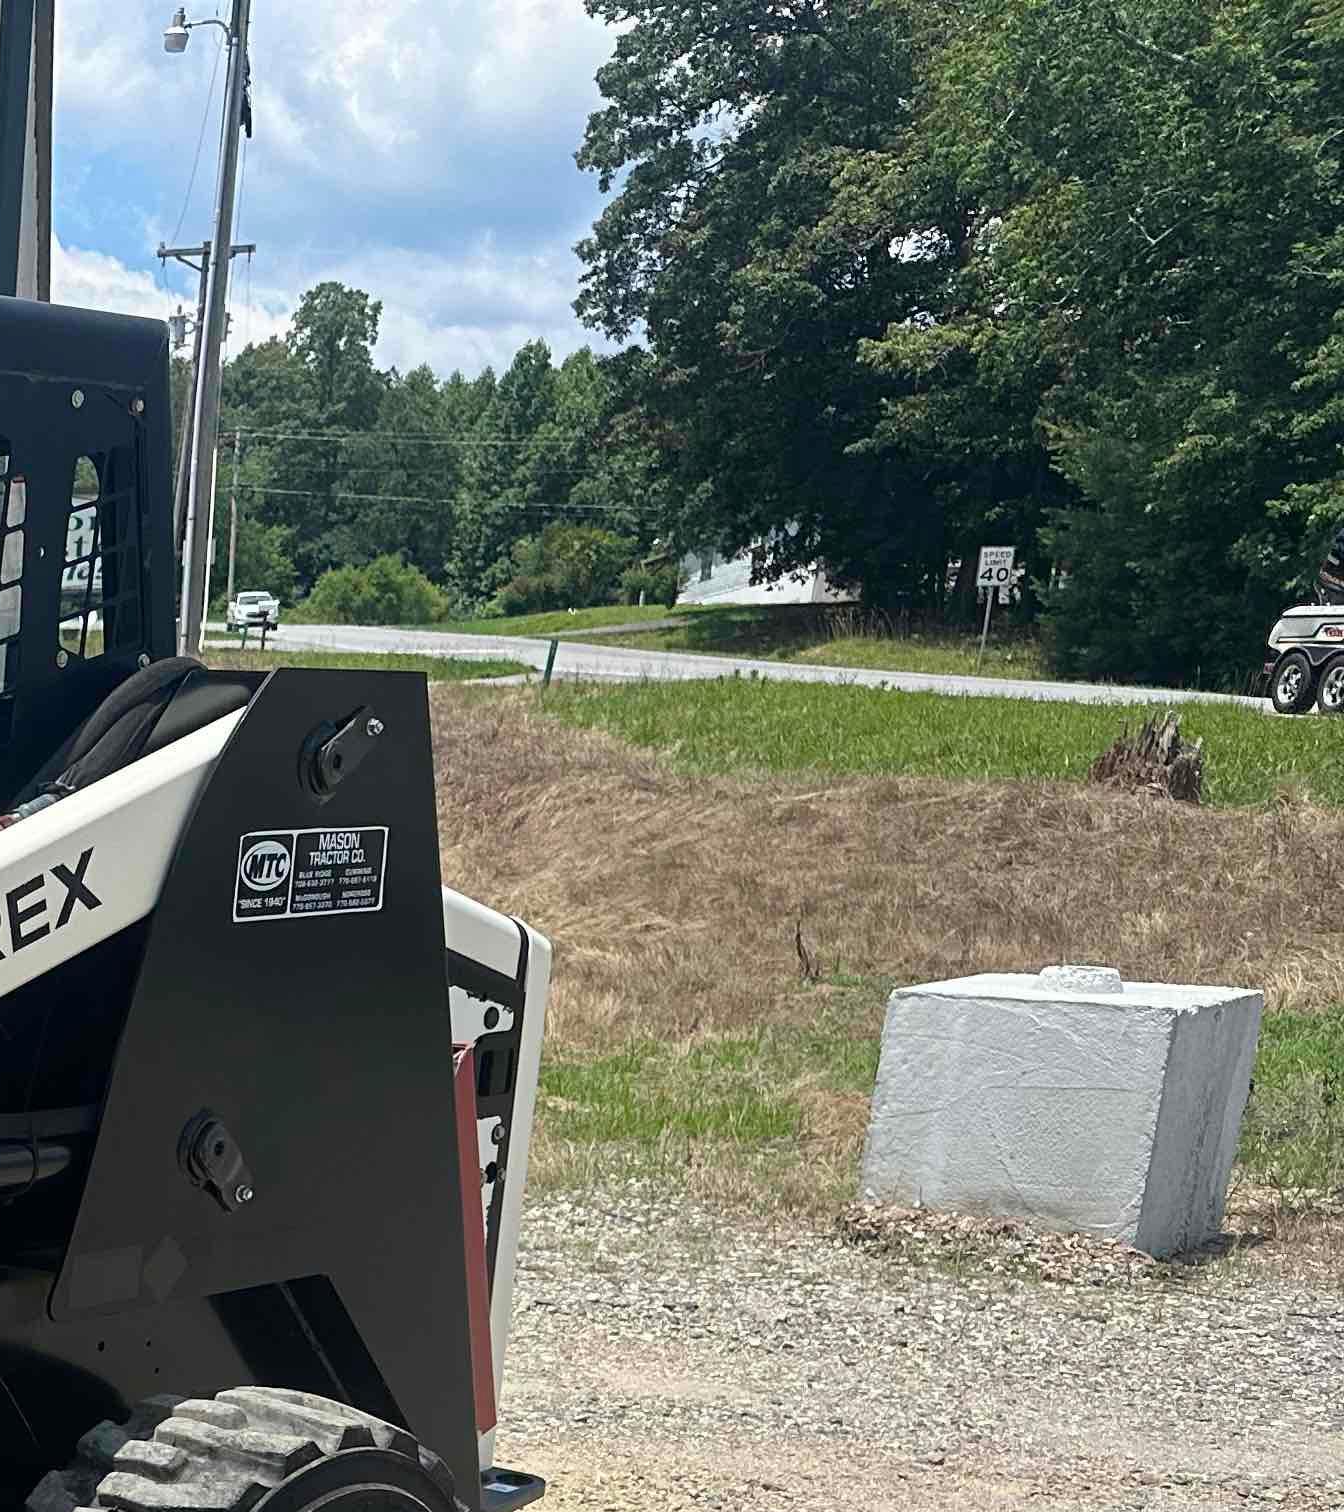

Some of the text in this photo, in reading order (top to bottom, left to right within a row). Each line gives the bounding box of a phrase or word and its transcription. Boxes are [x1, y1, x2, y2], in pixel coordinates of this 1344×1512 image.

[980, 567, 1009, 582] 40
[318, 832, 361, 850] MASON
[247, 852, 288, 880] MTC
[309, 849, 366, 866] TRACTOR CO.
